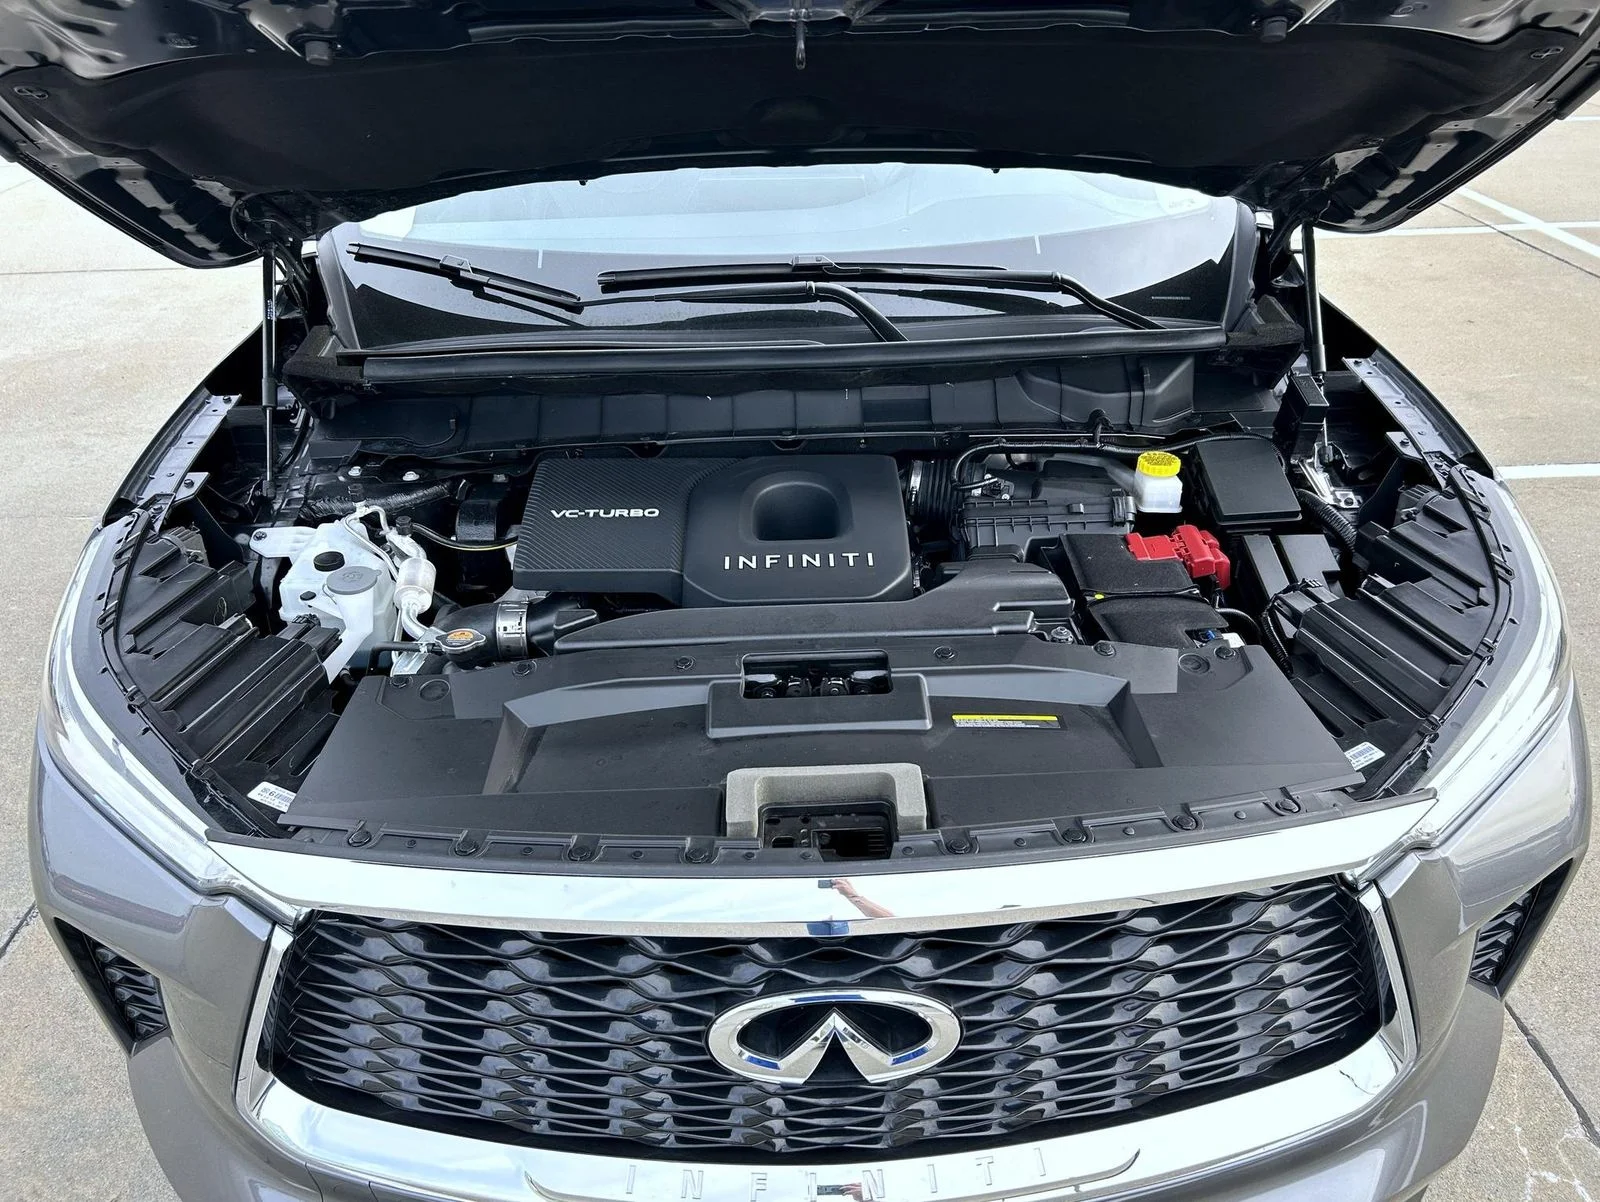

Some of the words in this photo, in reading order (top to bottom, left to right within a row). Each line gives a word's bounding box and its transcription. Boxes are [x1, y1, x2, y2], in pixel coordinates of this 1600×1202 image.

[551, 508, 660, 518] VC-TURBO
[724, 552, 874, 570] INFINITI
[626, 1148, 1047, 1202] INFINITI
